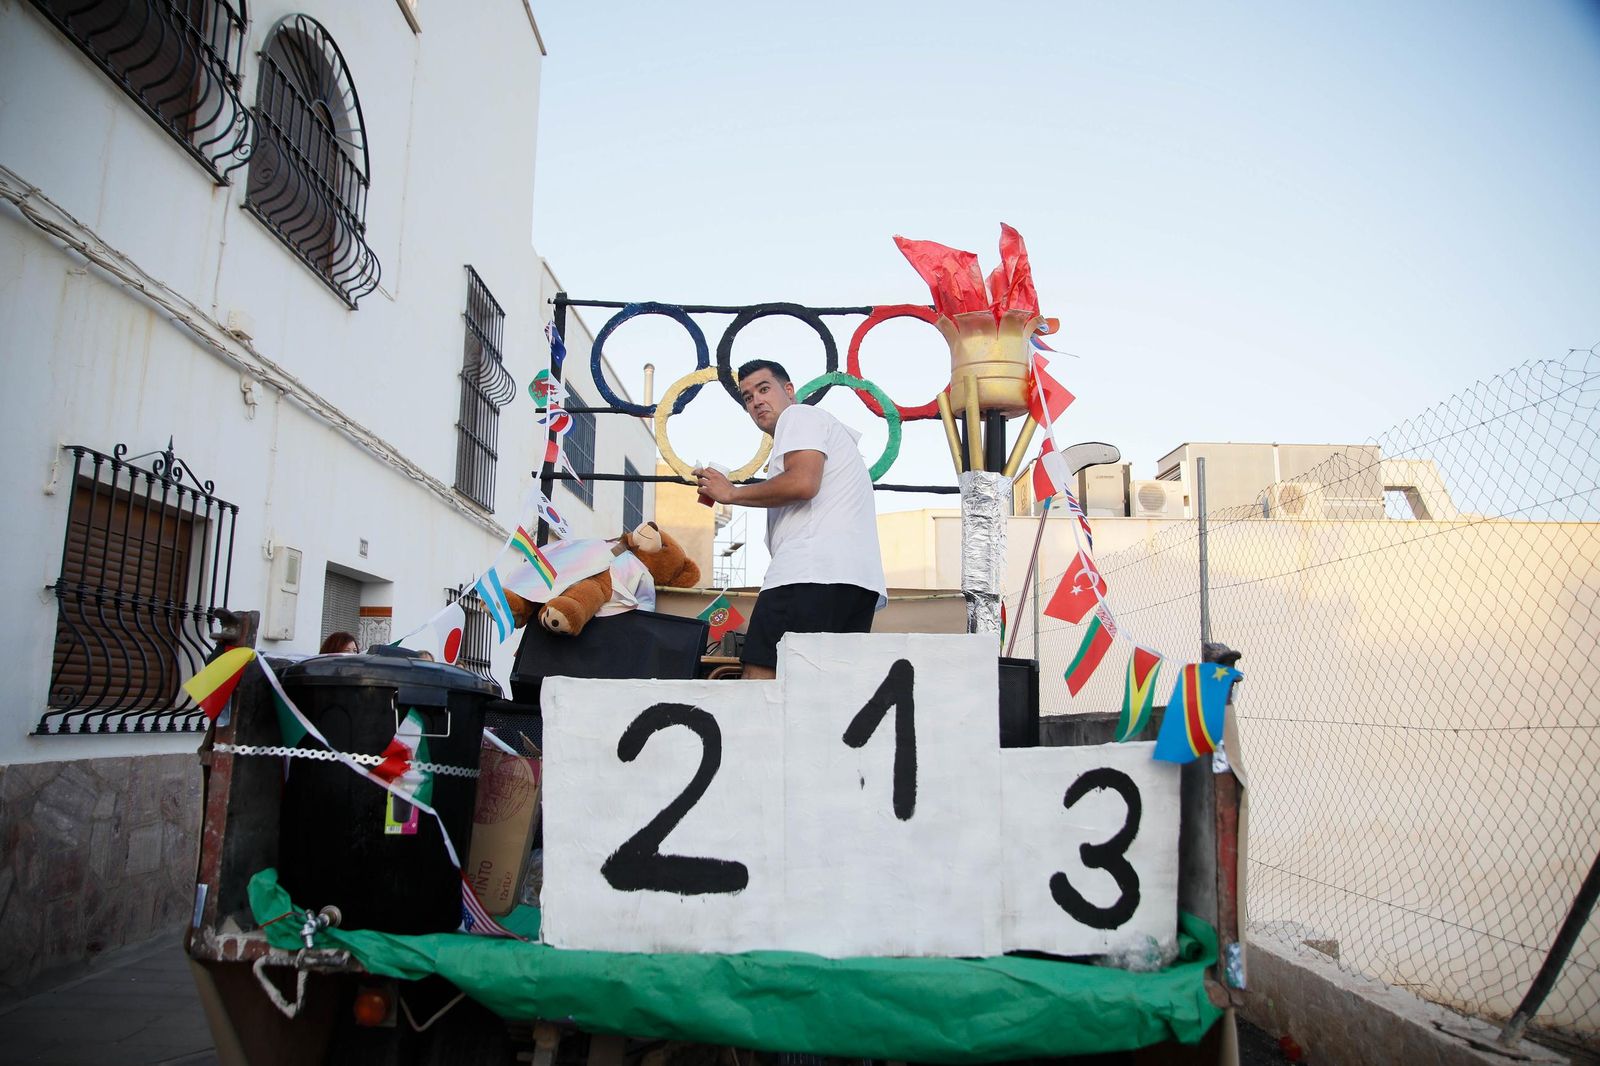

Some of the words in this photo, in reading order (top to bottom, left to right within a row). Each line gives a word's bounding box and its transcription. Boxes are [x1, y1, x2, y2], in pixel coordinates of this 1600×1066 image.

[600, 701, 749, 896] 2
[842, 658, 918, 822] 1
[1049, 767, 1142, 931] 3
